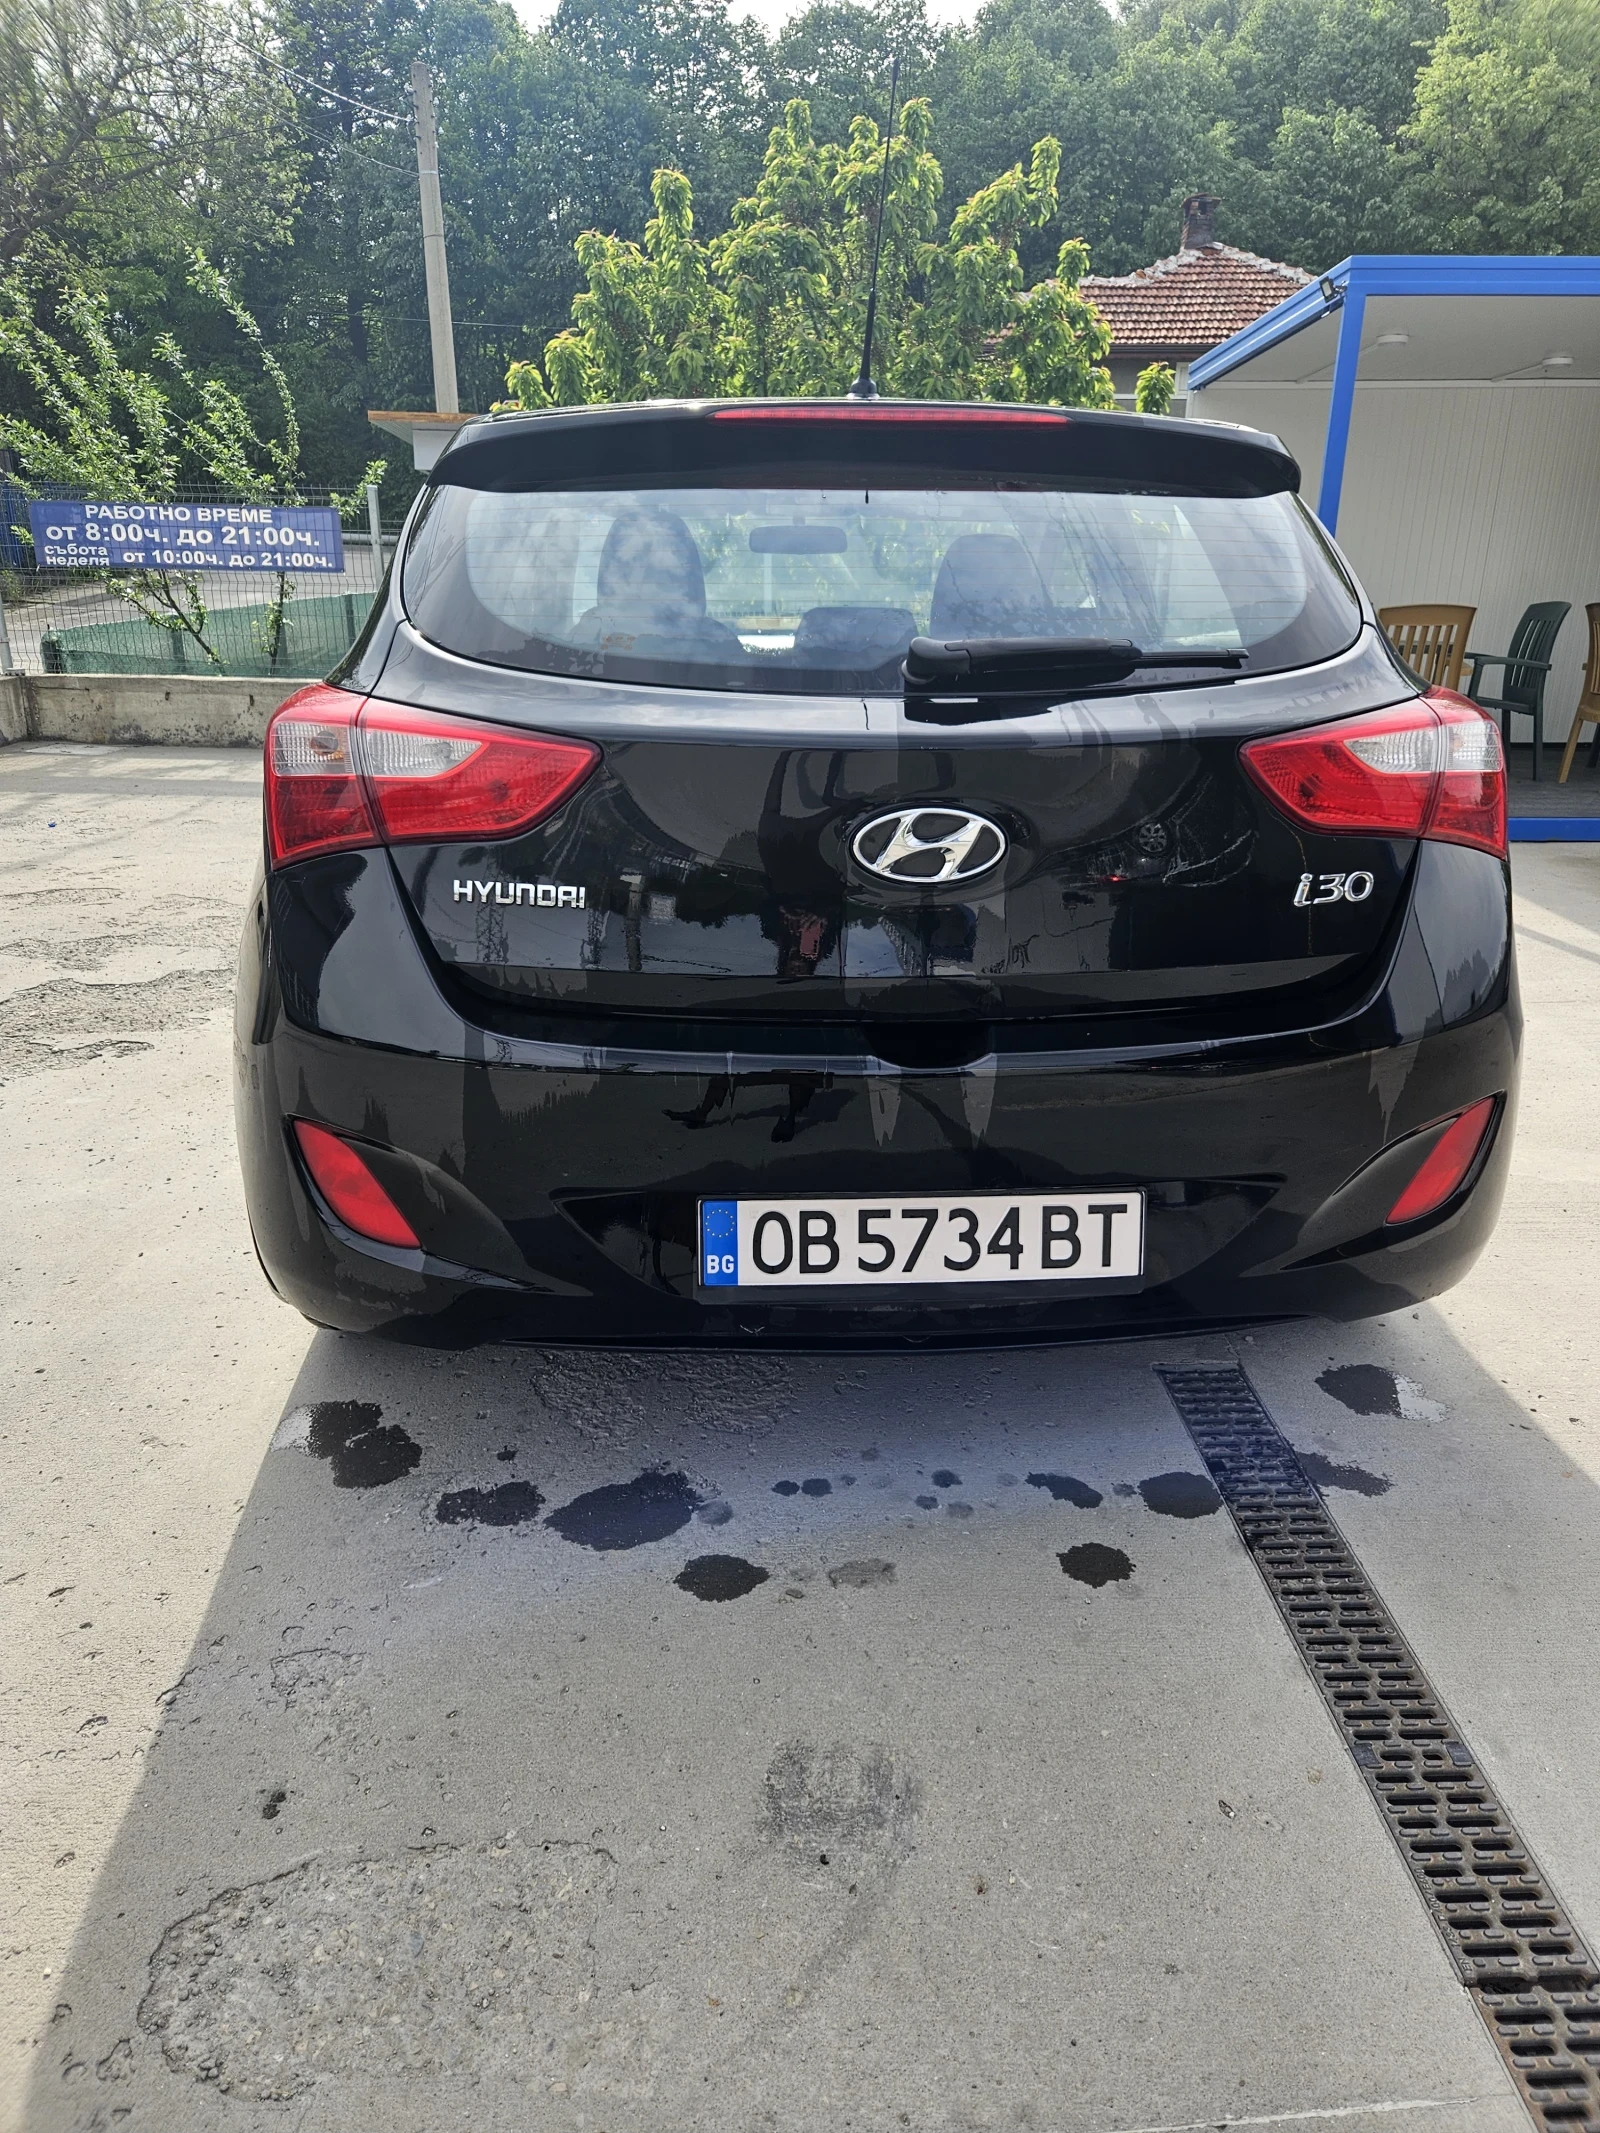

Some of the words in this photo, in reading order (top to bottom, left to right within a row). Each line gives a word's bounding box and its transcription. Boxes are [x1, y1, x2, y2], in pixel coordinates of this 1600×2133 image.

[85, 505, 190, 521] РАБОТНО
[197, 508, 273, 523] ВРЕМЕ
[46, 526, 76, 540] от
[85, 523, 168, 542] 8:00ч.
[177, 529, 213, 546] до
[221, 526, 320, 546] 21:00ч.
[44, 543, 108, 556] събота
[123, 552, 145, 563] от
[152, 549, 223, 565] 10:00ч.
[229, 555, 255, 567] до
[261, 552, 333, 567] 21:00ч.
[46, 556, 110, 567] неделя
[453, 879, 586, 909] HYUNDAI
[1294, 871, 1374, 907] i30
[857, 1207, 1024, 1272] 5734
[706, 1255, 735, 1274] BG
